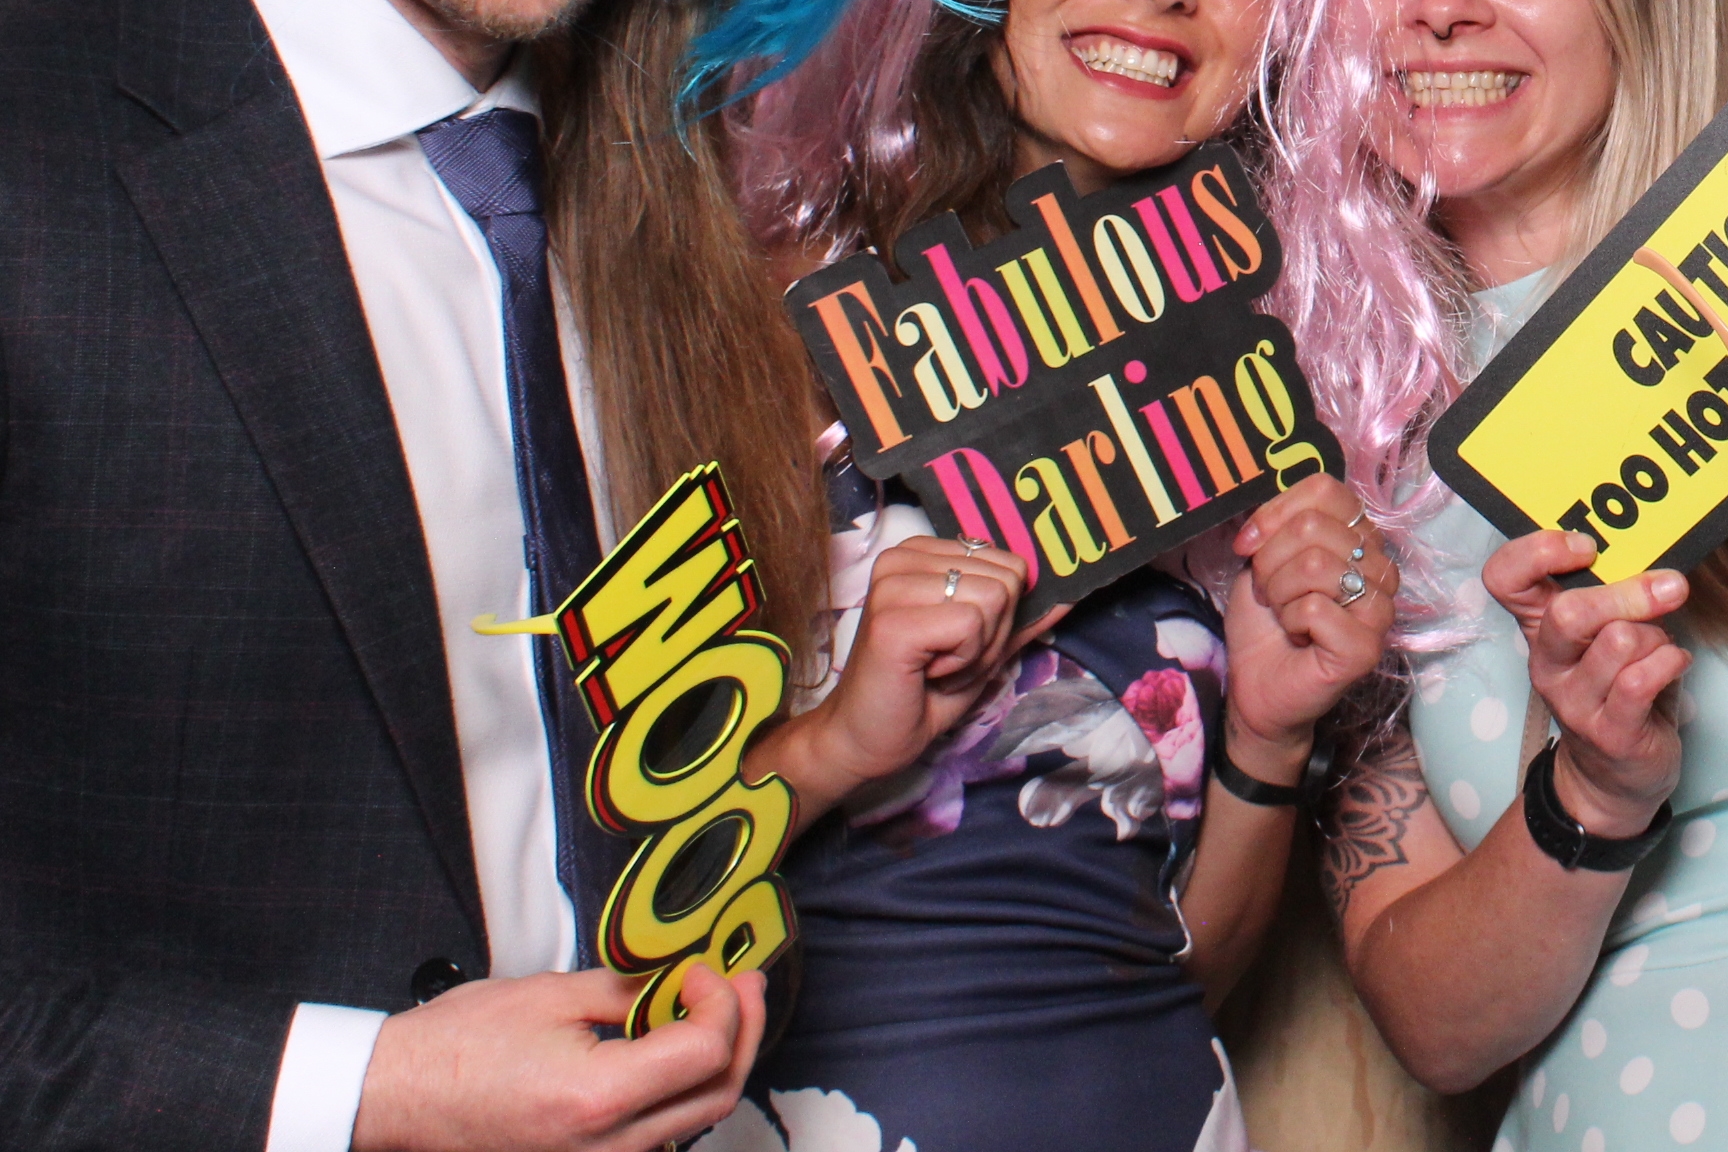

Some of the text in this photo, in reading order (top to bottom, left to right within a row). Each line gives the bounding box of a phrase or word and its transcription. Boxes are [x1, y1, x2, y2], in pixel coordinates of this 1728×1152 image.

[807, 163, 1263, 454] Fabulous
[923, 339, 1326, 594] Darling
[1556, 454, 1670, 556] TOO
